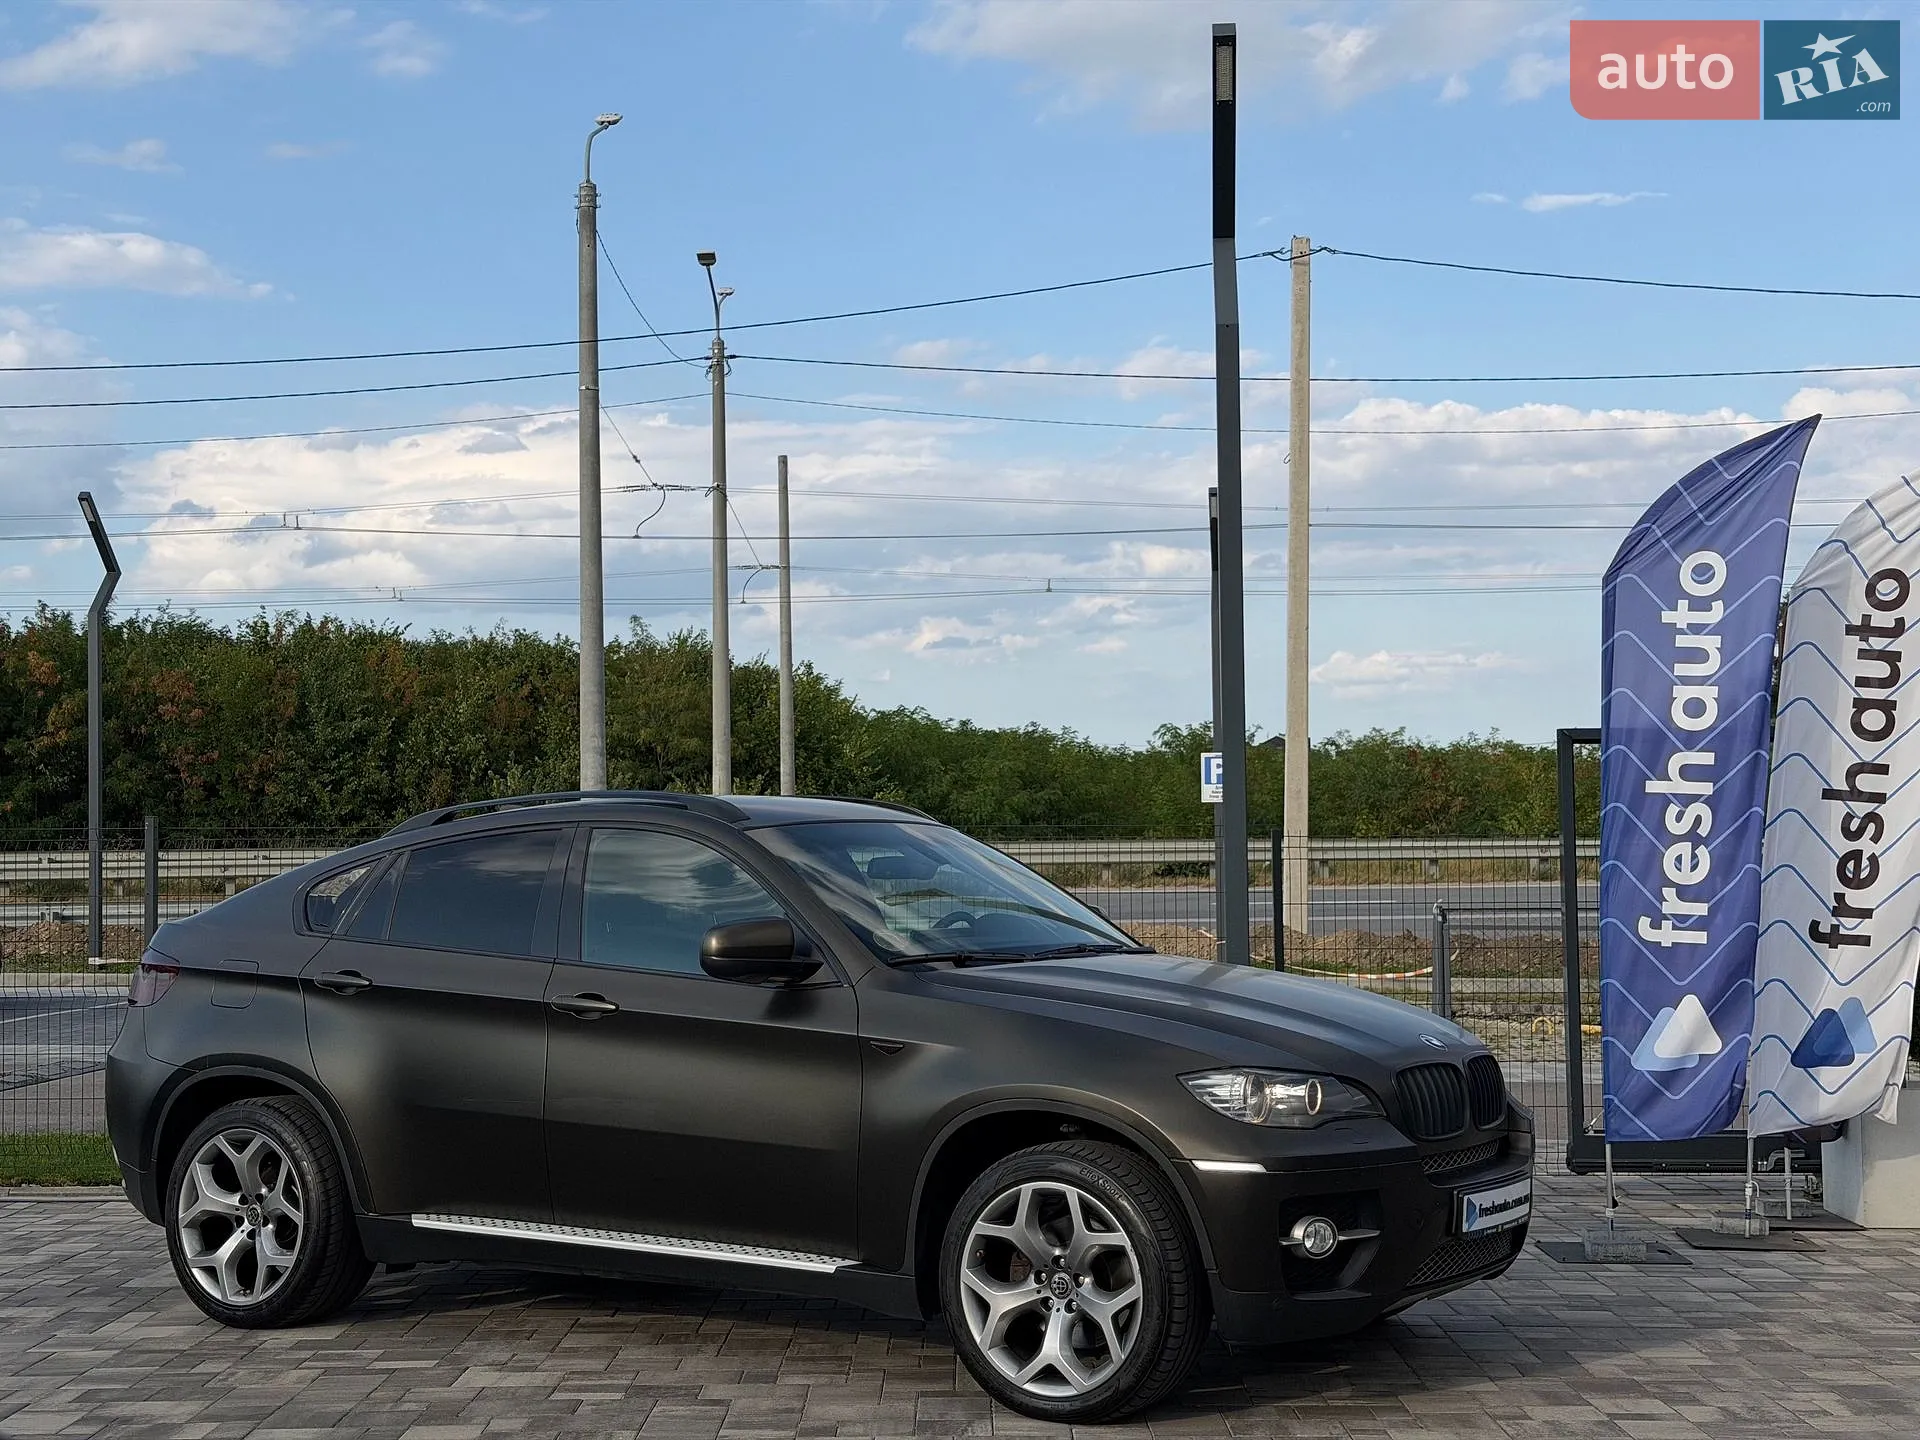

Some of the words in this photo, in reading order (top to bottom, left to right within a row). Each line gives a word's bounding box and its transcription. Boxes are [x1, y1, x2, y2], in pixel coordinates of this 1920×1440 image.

[1661, 549, 1727, 732] auto
[1844, 567, 1911, 743] auto
[1638, 751, 1717, 946] fresh
[1808, 765, 1891, 949] fresh
